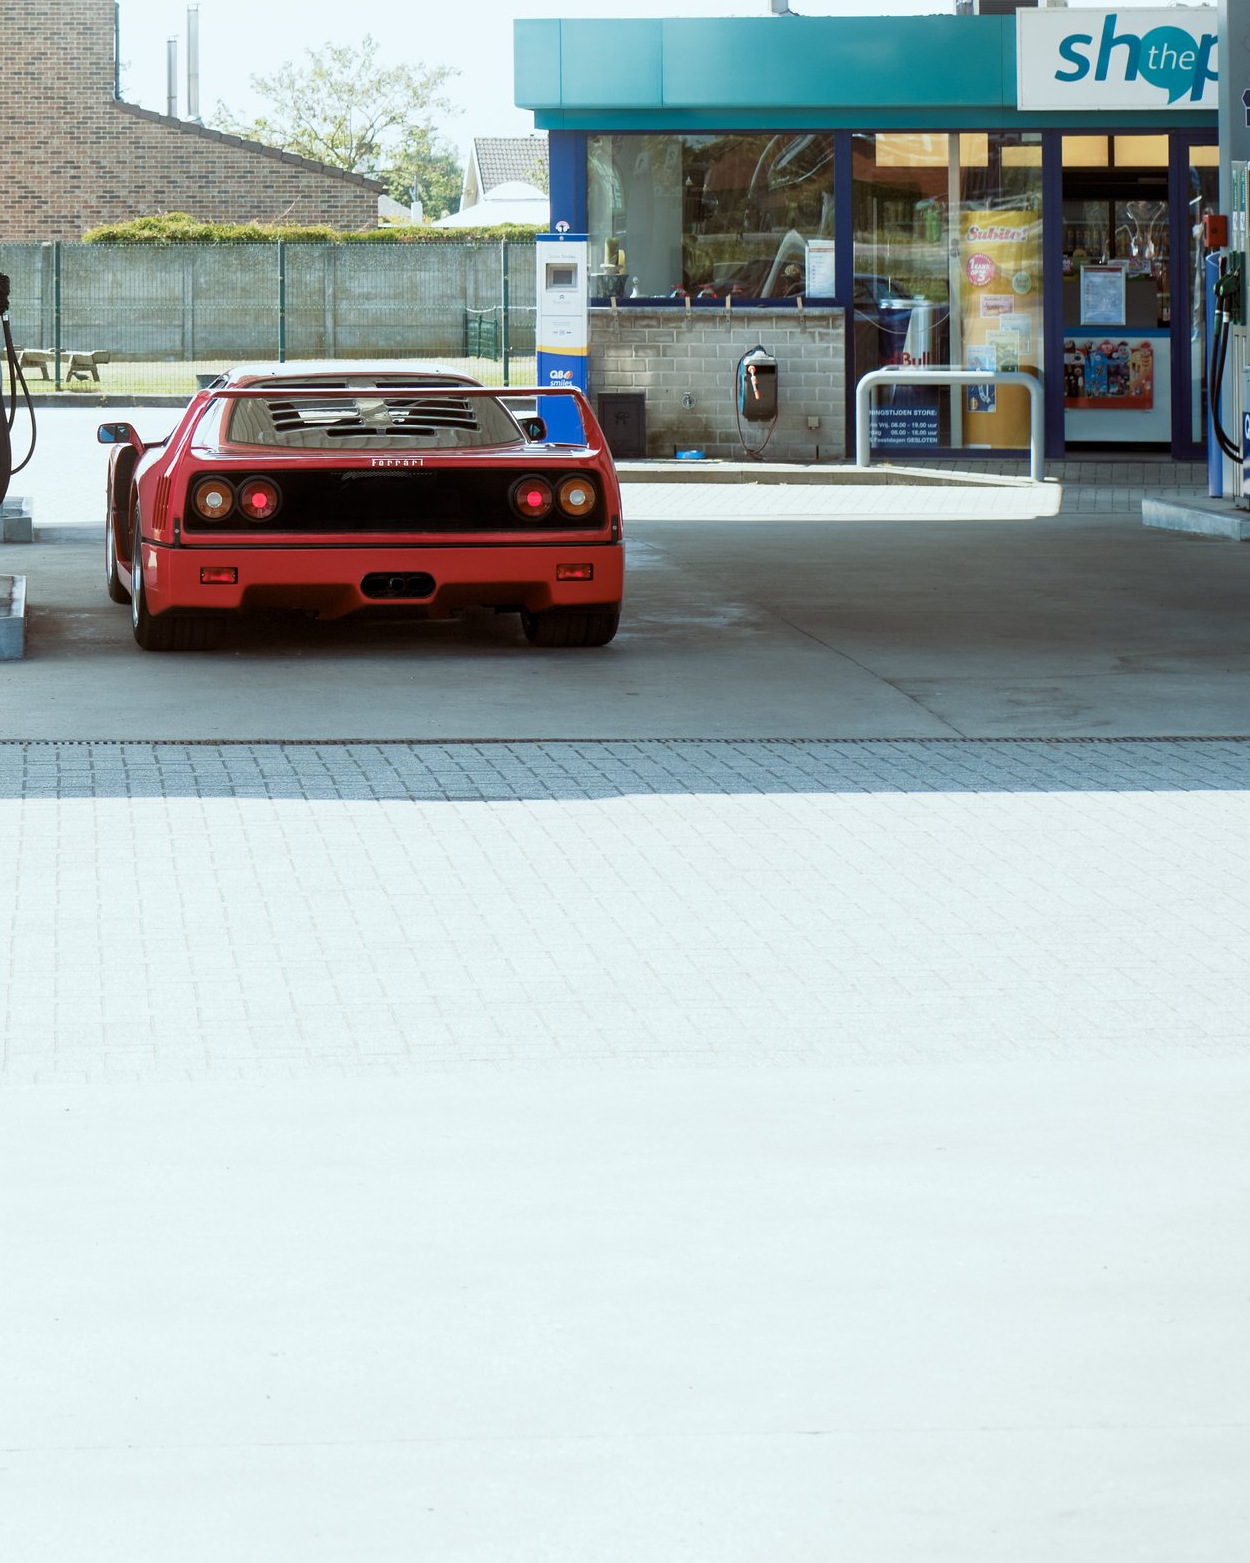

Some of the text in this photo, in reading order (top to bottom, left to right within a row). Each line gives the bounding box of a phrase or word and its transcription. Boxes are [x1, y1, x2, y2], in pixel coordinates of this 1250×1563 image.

[1149, 42, 1196, 70] the
[969, 258, 975, 268] 1
[978, 270, 987, 282] 3
[550, 370, 563, 379] Q8
